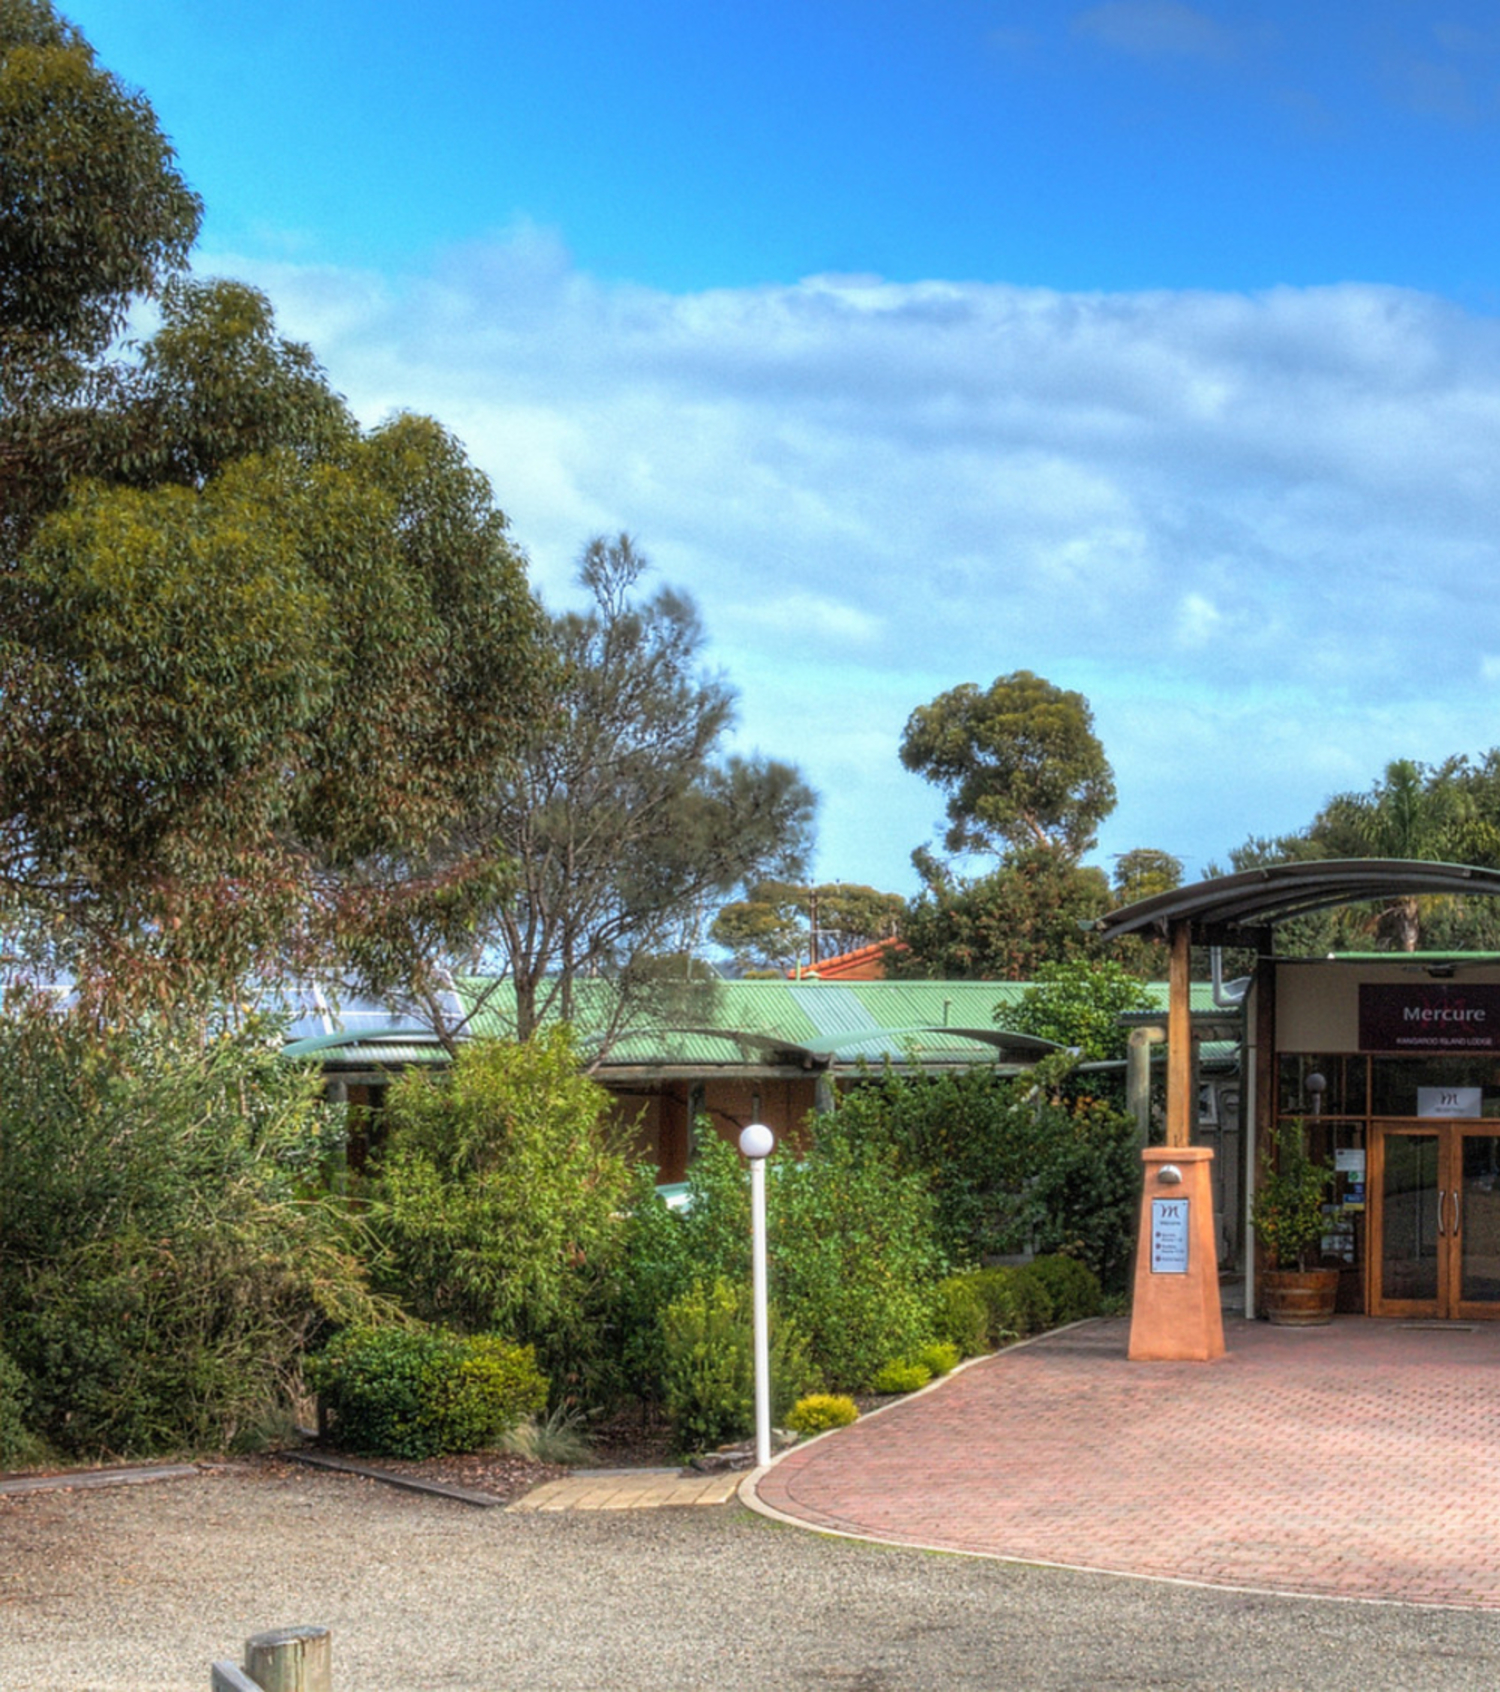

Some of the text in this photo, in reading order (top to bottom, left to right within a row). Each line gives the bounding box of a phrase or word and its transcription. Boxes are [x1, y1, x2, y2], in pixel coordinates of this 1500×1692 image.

[1403, 1006, 1486, 1021] Mercure
[1396, 1037, 1492, 1046] KANGAROO ISLAND LODGE
